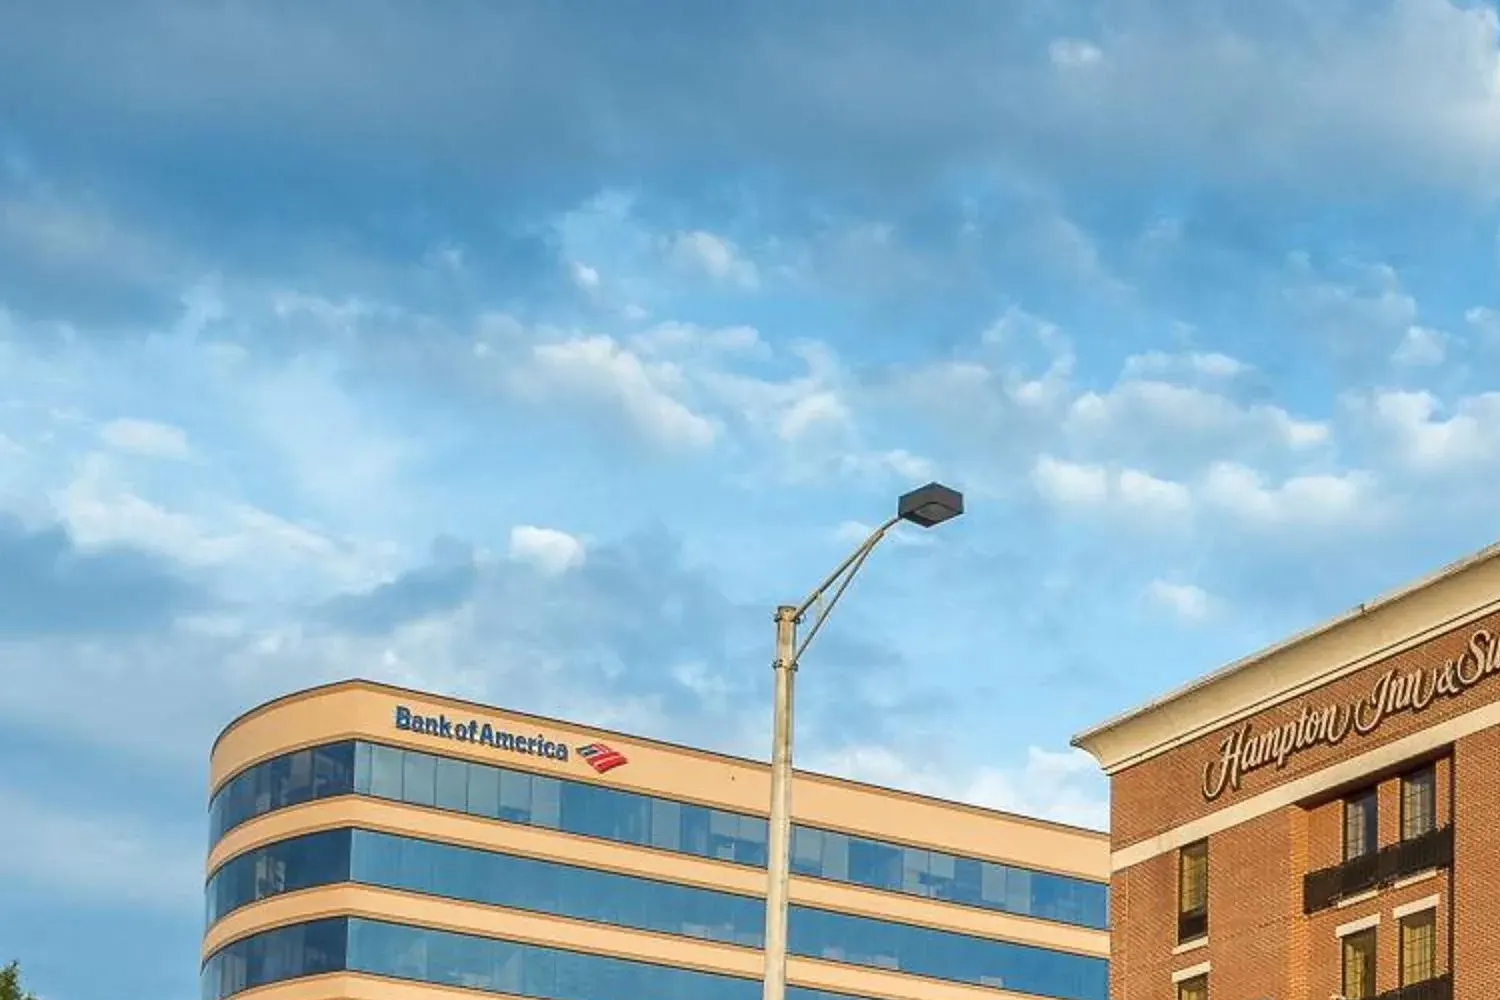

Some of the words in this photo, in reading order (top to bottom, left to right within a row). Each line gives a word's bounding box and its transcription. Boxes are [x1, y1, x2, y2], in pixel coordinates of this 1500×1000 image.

[395, 704, 452, 739] Bank
[453, 719, 479, 744] of
[479, 723, 569, 762] America
[1203, 703, 1350, 799] Hampton
[1356, 667, 1438, 732] Inn
